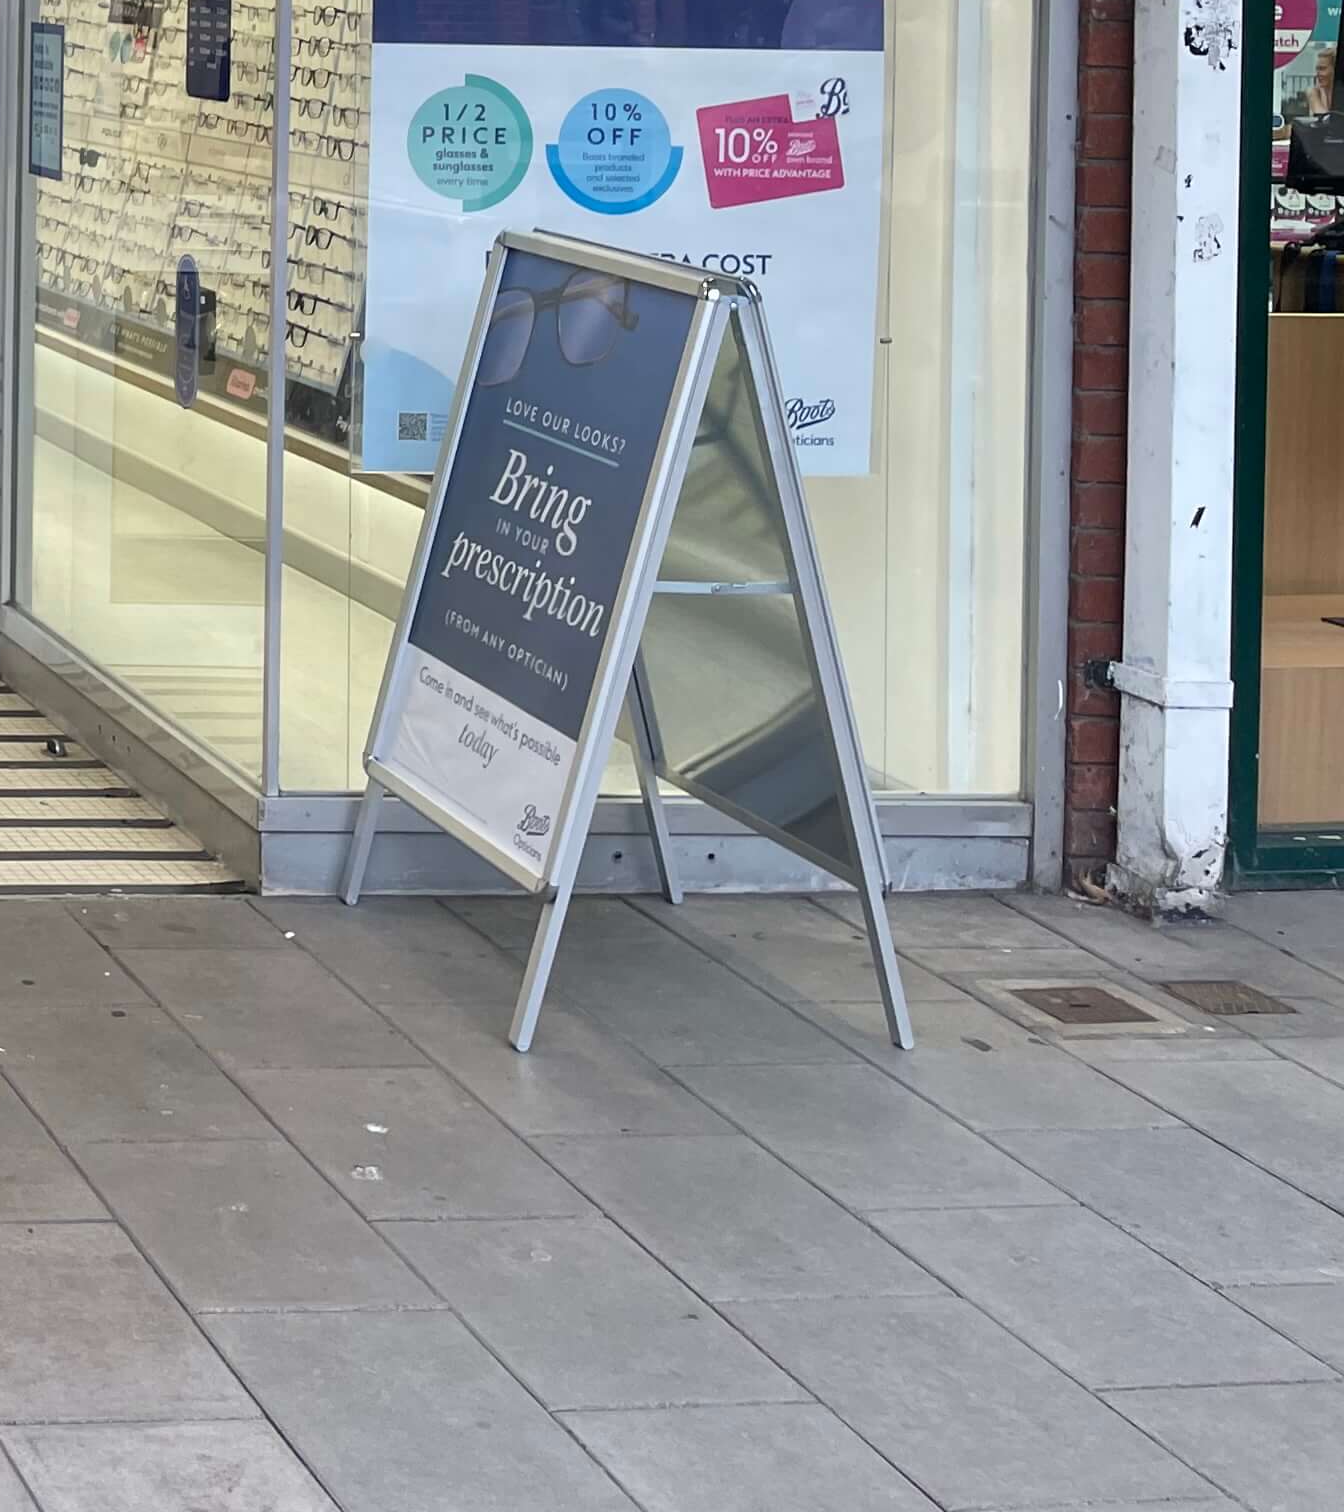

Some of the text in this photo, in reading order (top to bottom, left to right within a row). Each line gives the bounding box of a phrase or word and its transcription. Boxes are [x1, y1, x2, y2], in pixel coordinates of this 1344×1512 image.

[443, 103, 486, 121] 1/2
[592, 103, 642, 121] 10%
[422, 126, 507, 145] PRICE
[587, 128, 643, 146] OFF
[715, 128, 778, 164] 10%
[433, 161, 494, 174] sunglasses
[435, 148, 489, 161] glasses &
[752, 154, 778, 164] OFF
[714, 167, 832, 179] WITH PRICE ADVANTAGE
[702, 254, 772, 274] COST
[505, 396, 626, 455] LOVE OUR LOOKS?
[785, 398, 836, 430] Boots
[489, 449, 592, 557] Bring
[496, 518, 550, 556] IN YOUR
[441, 531, 605, 638] prescription
[445, 609, 569, 691] (FROM ANY OPTICIAN)
[419, 666, 562, 766] Come in and see what's possible
[458, 723, 499, 769] today
[517, 804, 551, 836] Boots
[513, 833, 542, 863] Opticians
